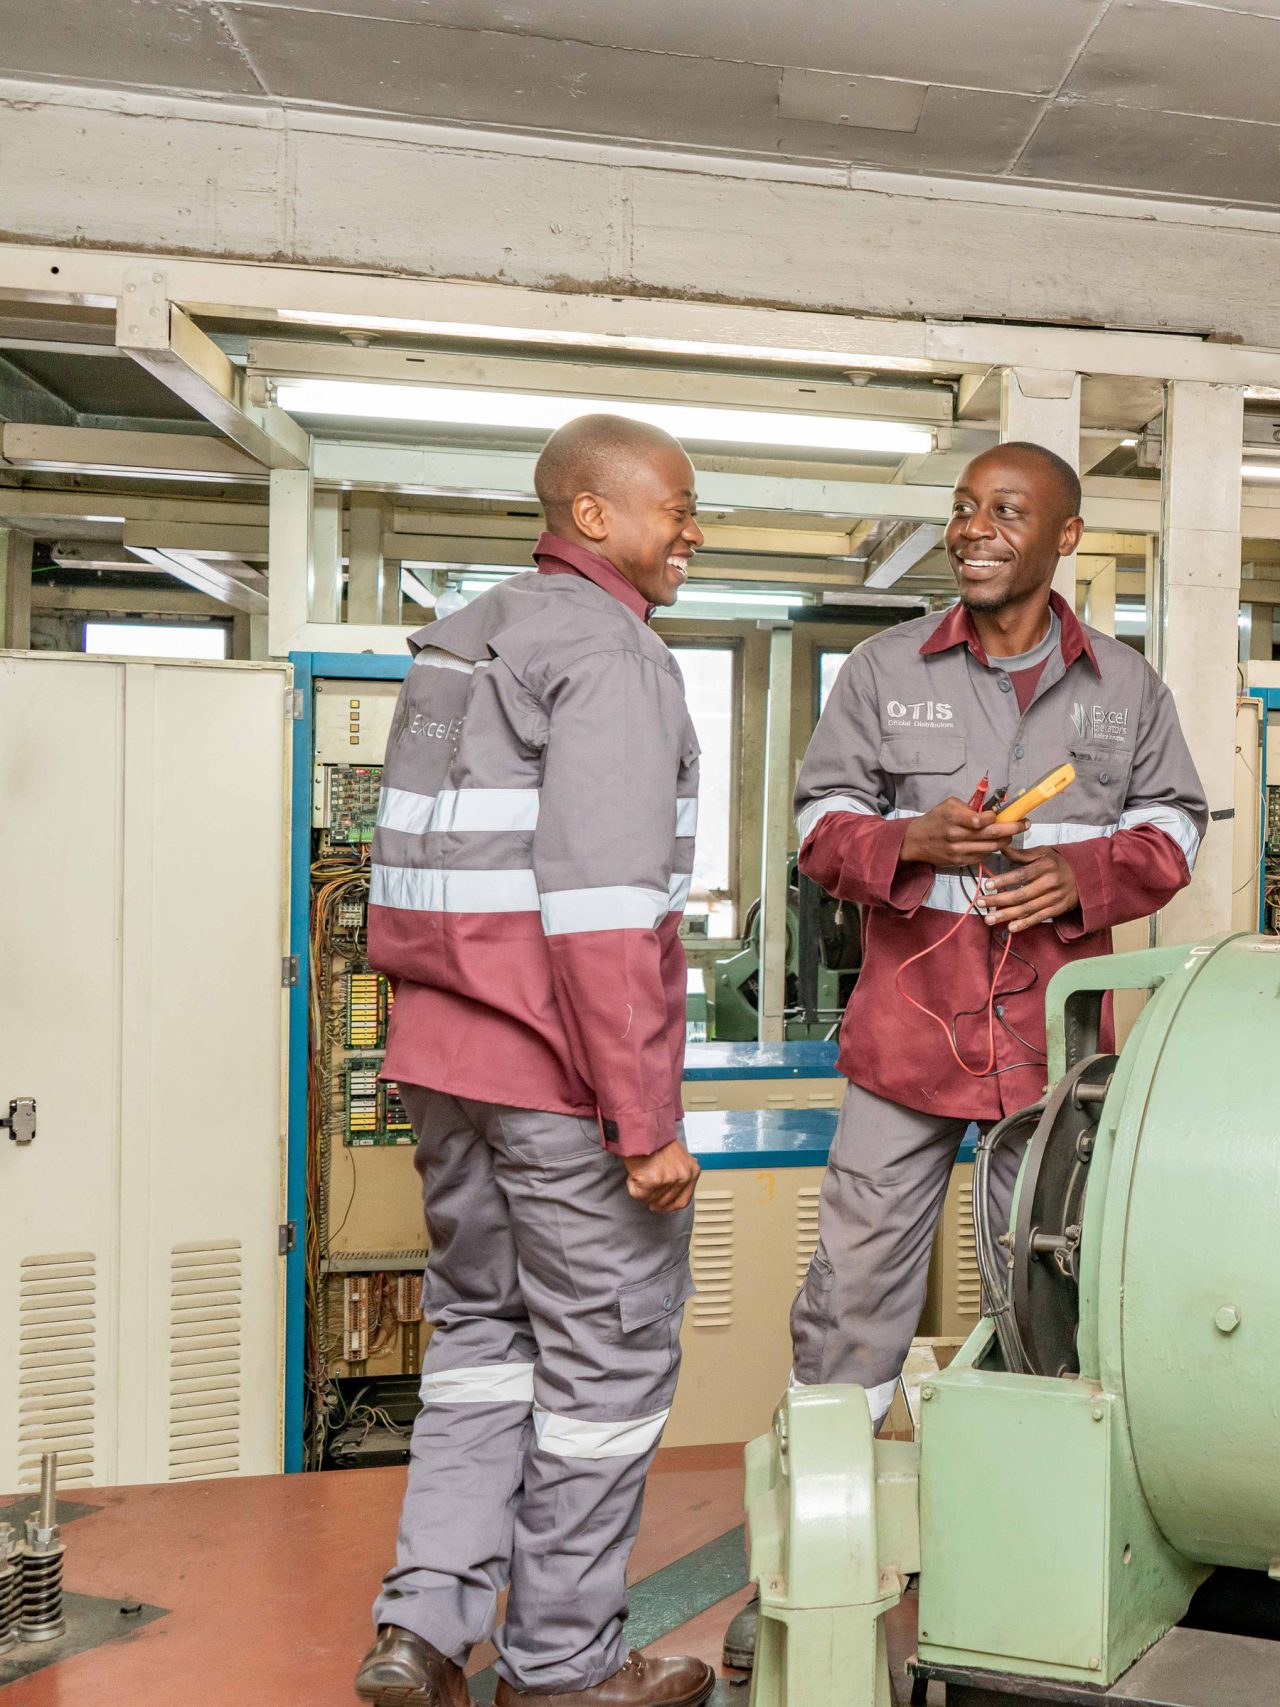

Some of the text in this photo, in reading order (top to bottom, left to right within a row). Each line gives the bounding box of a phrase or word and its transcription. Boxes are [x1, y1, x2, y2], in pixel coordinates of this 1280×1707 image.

[886, 700, 953, 721] OTIS
[1093, 705, 1128, 725] Excel
[410, 714, 453, 740] Excel
